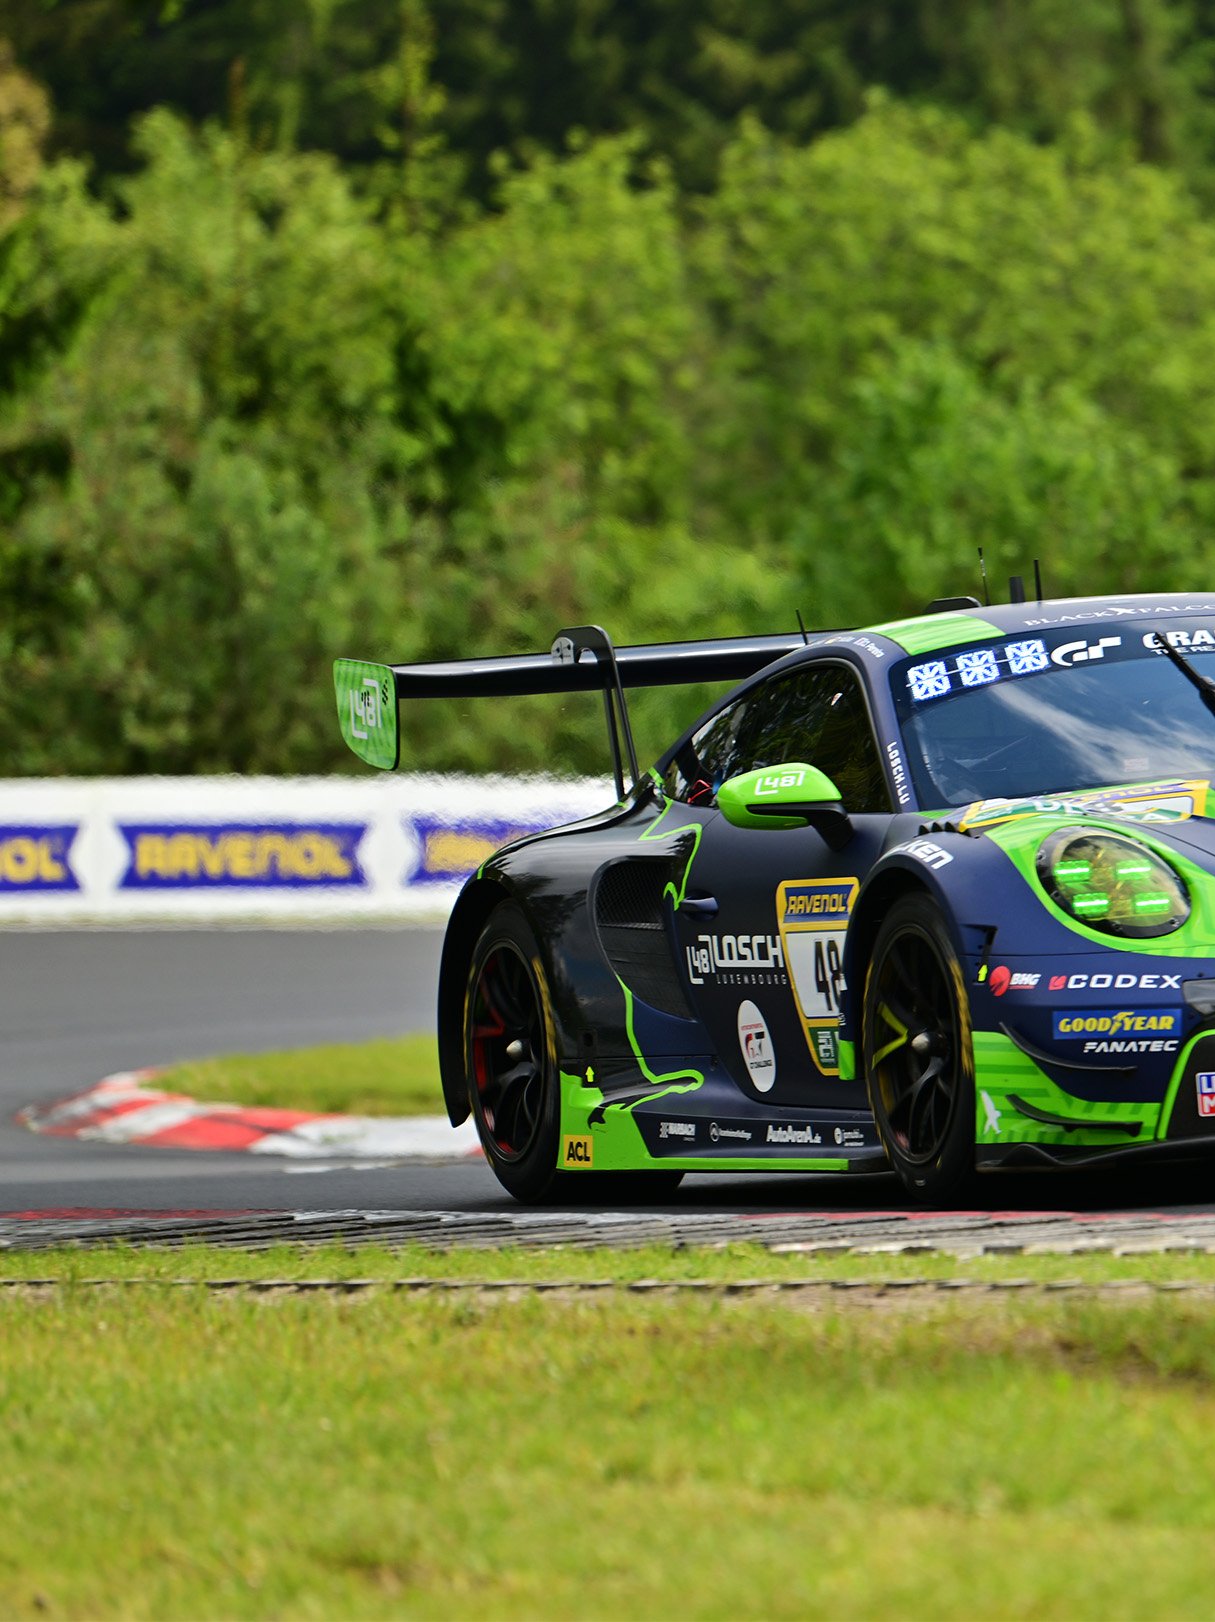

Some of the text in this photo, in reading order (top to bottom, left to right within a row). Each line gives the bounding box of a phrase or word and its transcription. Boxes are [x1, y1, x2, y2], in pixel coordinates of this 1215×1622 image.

[1024, 611, 1108, 626] BLACK
[134, 830, 352, 880] RAVENOL
[787, 893, 848, 914] RAVENOL
[713, 935, 785, 968] LOSCH
[716, 974, 788, 985] LUXEMBOURG
[1011, 973, 1041, 986] BHG
[1067, 974, 1182, 989] CODEX
[1058, 1011, 1175, 1036] GOODYEAR
[1083, 1039, 1179, 1053] FANATEC
[566, 1141, 591, 1162] ACL
